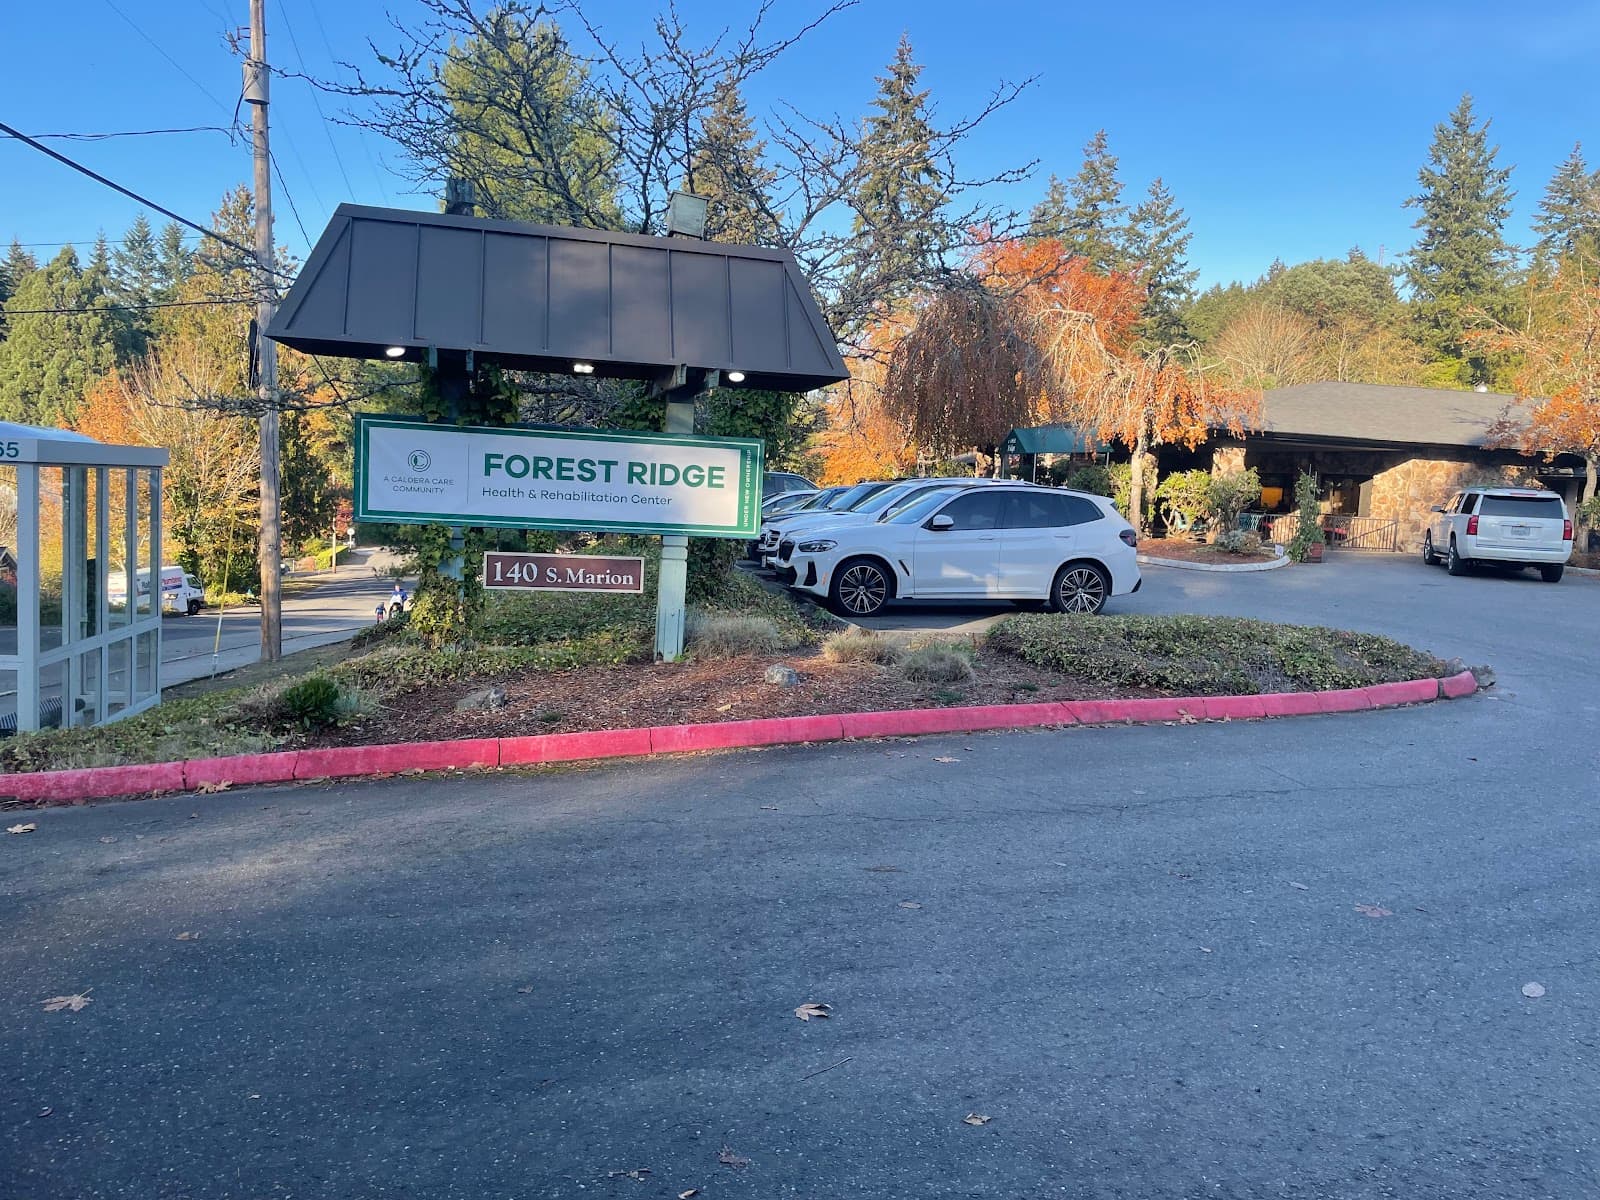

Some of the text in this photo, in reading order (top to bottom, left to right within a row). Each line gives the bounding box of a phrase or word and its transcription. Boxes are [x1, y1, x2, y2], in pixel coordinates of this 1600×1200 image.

[484, 453, 725, 489] FOREST RIDGE
[383, 475, 455, 486] A CALDERA CARE
[392, 485, 445, 495] COMMUNITY
[482, 487, 673, 505] Health & Rehabilitation Center
[493, 561, 635, 586] 140 S. Marion
